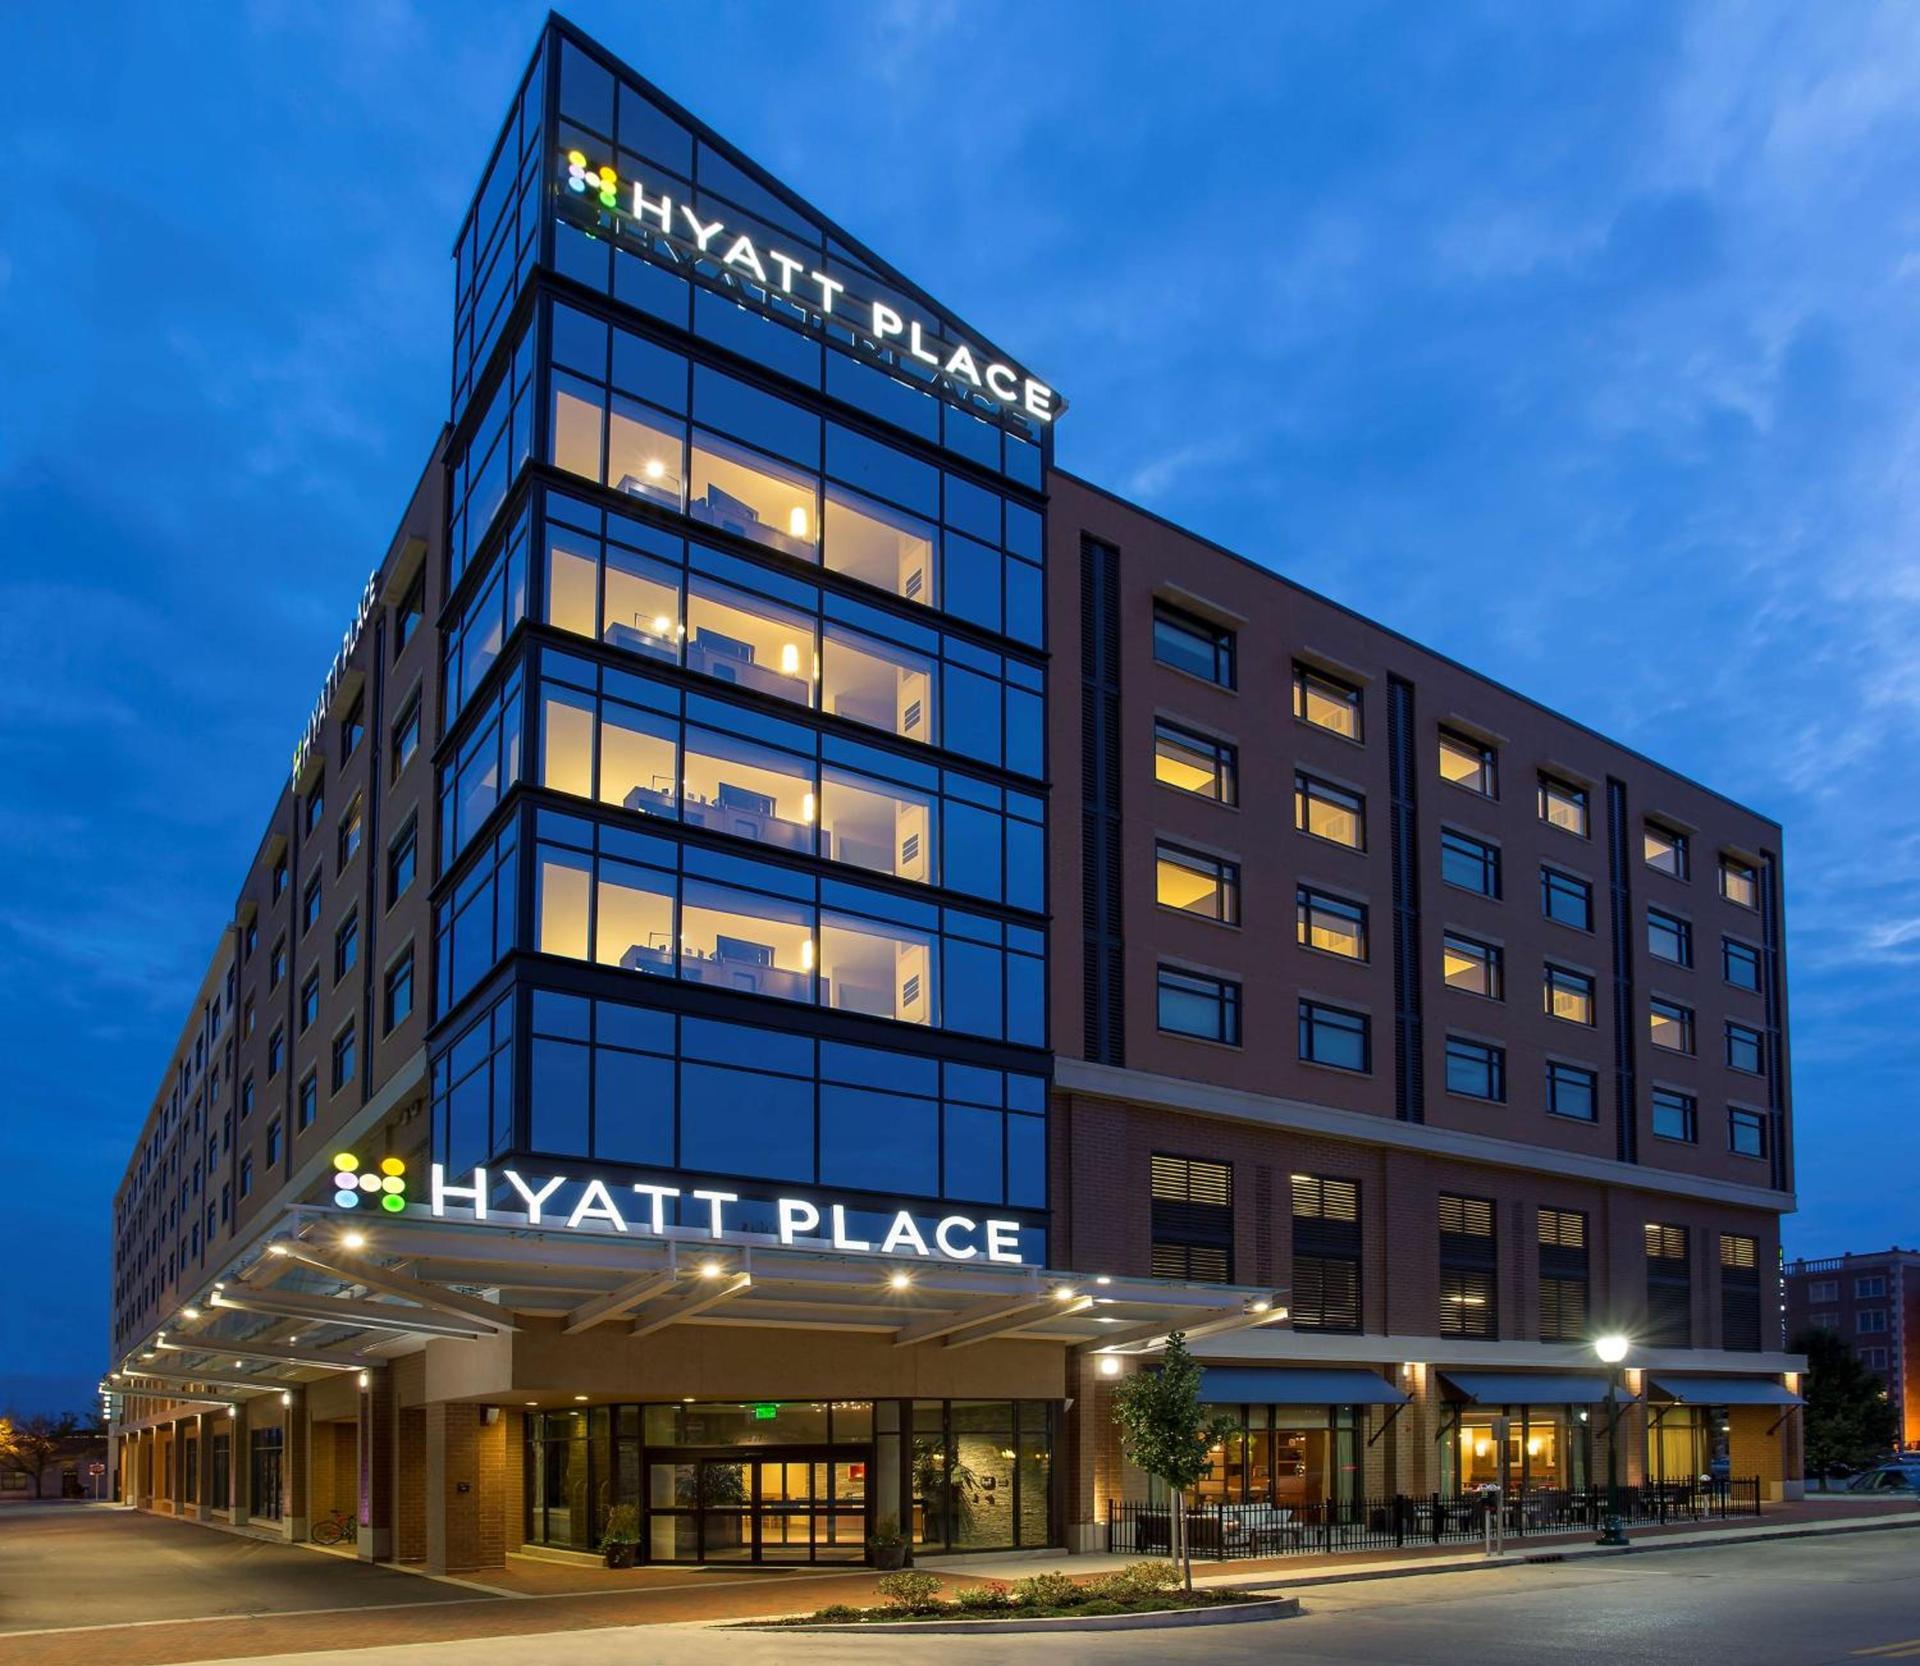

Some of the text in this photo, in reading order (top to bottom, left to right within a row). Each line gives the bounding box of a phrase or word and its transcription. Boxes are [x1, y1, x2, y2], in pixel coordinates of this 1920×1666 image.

[633, 181, 1053, 422] HYATT PLACE
[302, 569, 377, 769] HYATT PLACE
[431, 1163, 1023, 1264] HYATT PLACE
